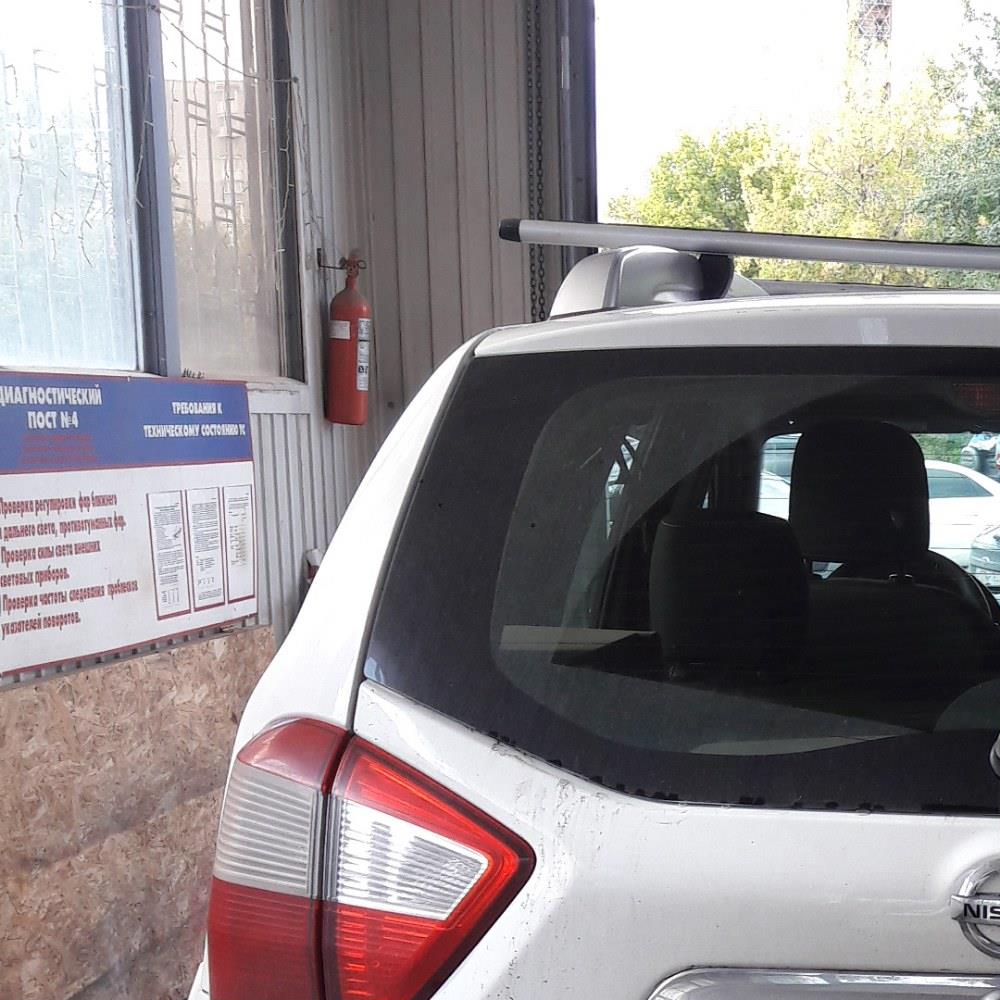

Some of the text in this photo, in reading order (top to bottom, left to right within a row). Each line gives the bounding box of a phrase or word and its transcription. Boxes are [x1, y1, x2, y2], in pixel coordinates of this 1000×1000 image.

[171, 401, 217, 415] ТРЕБОВАНИЯ
[27, 410, 57, 430] ПОСТ
[143, 423, 200, 438] ТЕХНИЧЕСКОМУ
